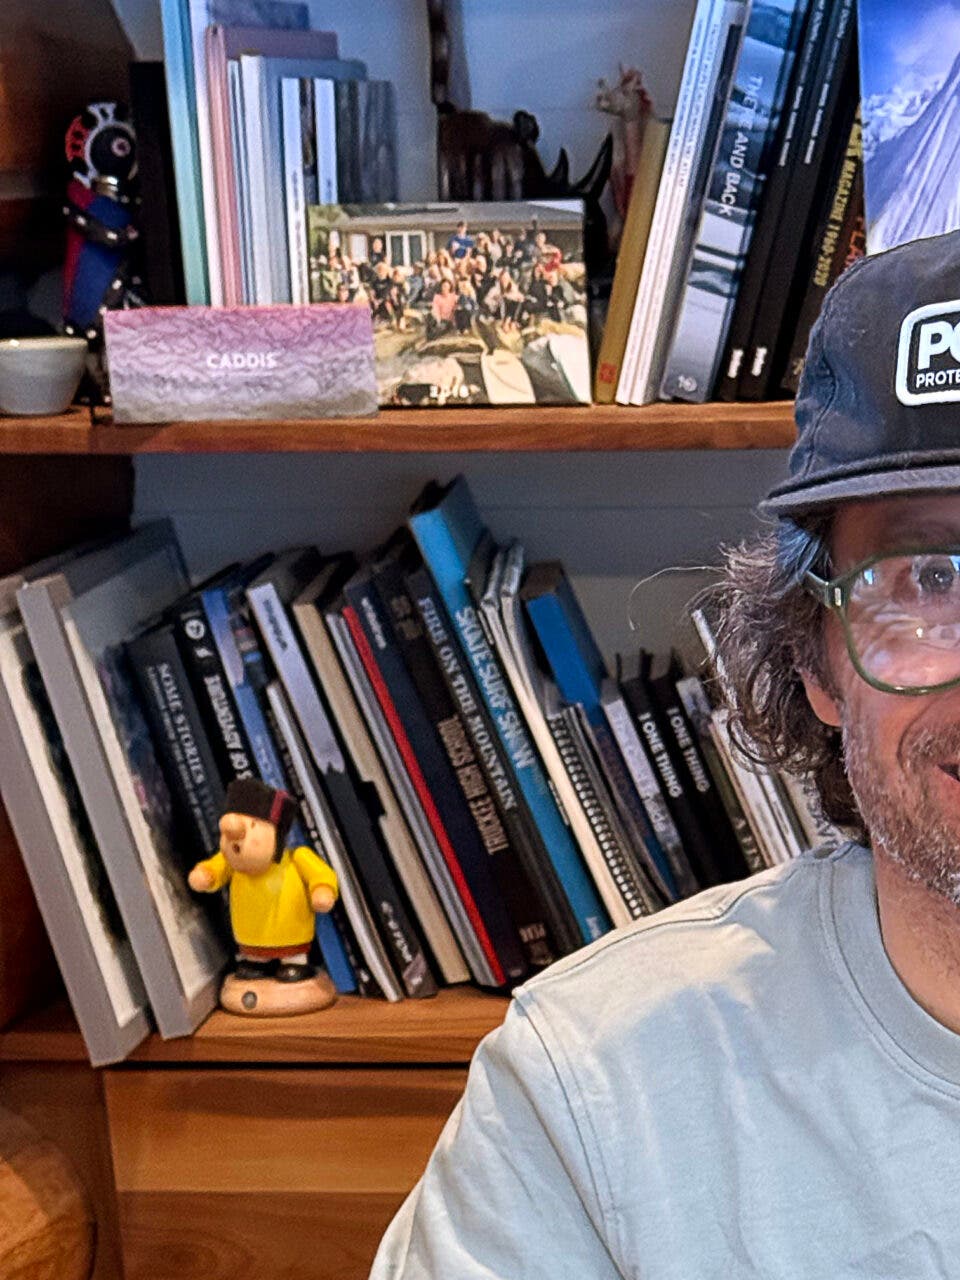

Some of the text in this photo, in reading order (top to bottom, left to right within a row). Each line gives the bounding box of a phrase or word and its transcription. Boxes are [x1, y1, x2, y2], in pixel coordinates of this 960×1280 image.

[719, 75, 763, 216] THEE AND BACK
[206, 352, 277, 369] CADDIS
[456, 607, 492, 668] SKATE
[478, 664, 512, 711] SURF
[157, 662, 205, 784] SOME STORIES
[440, 647, 459, 674] ON
[452, 673, 477, 714] THE
[468, 714, 517, 811] MOUNTAIN
[642, 721, 663, 752] ONE
[656, 751, 683, 798] THING
[669, 715, 692, 748] ONE
[684, 746, 711, 793] THING
[457, 764, 487, 799] HIGH
